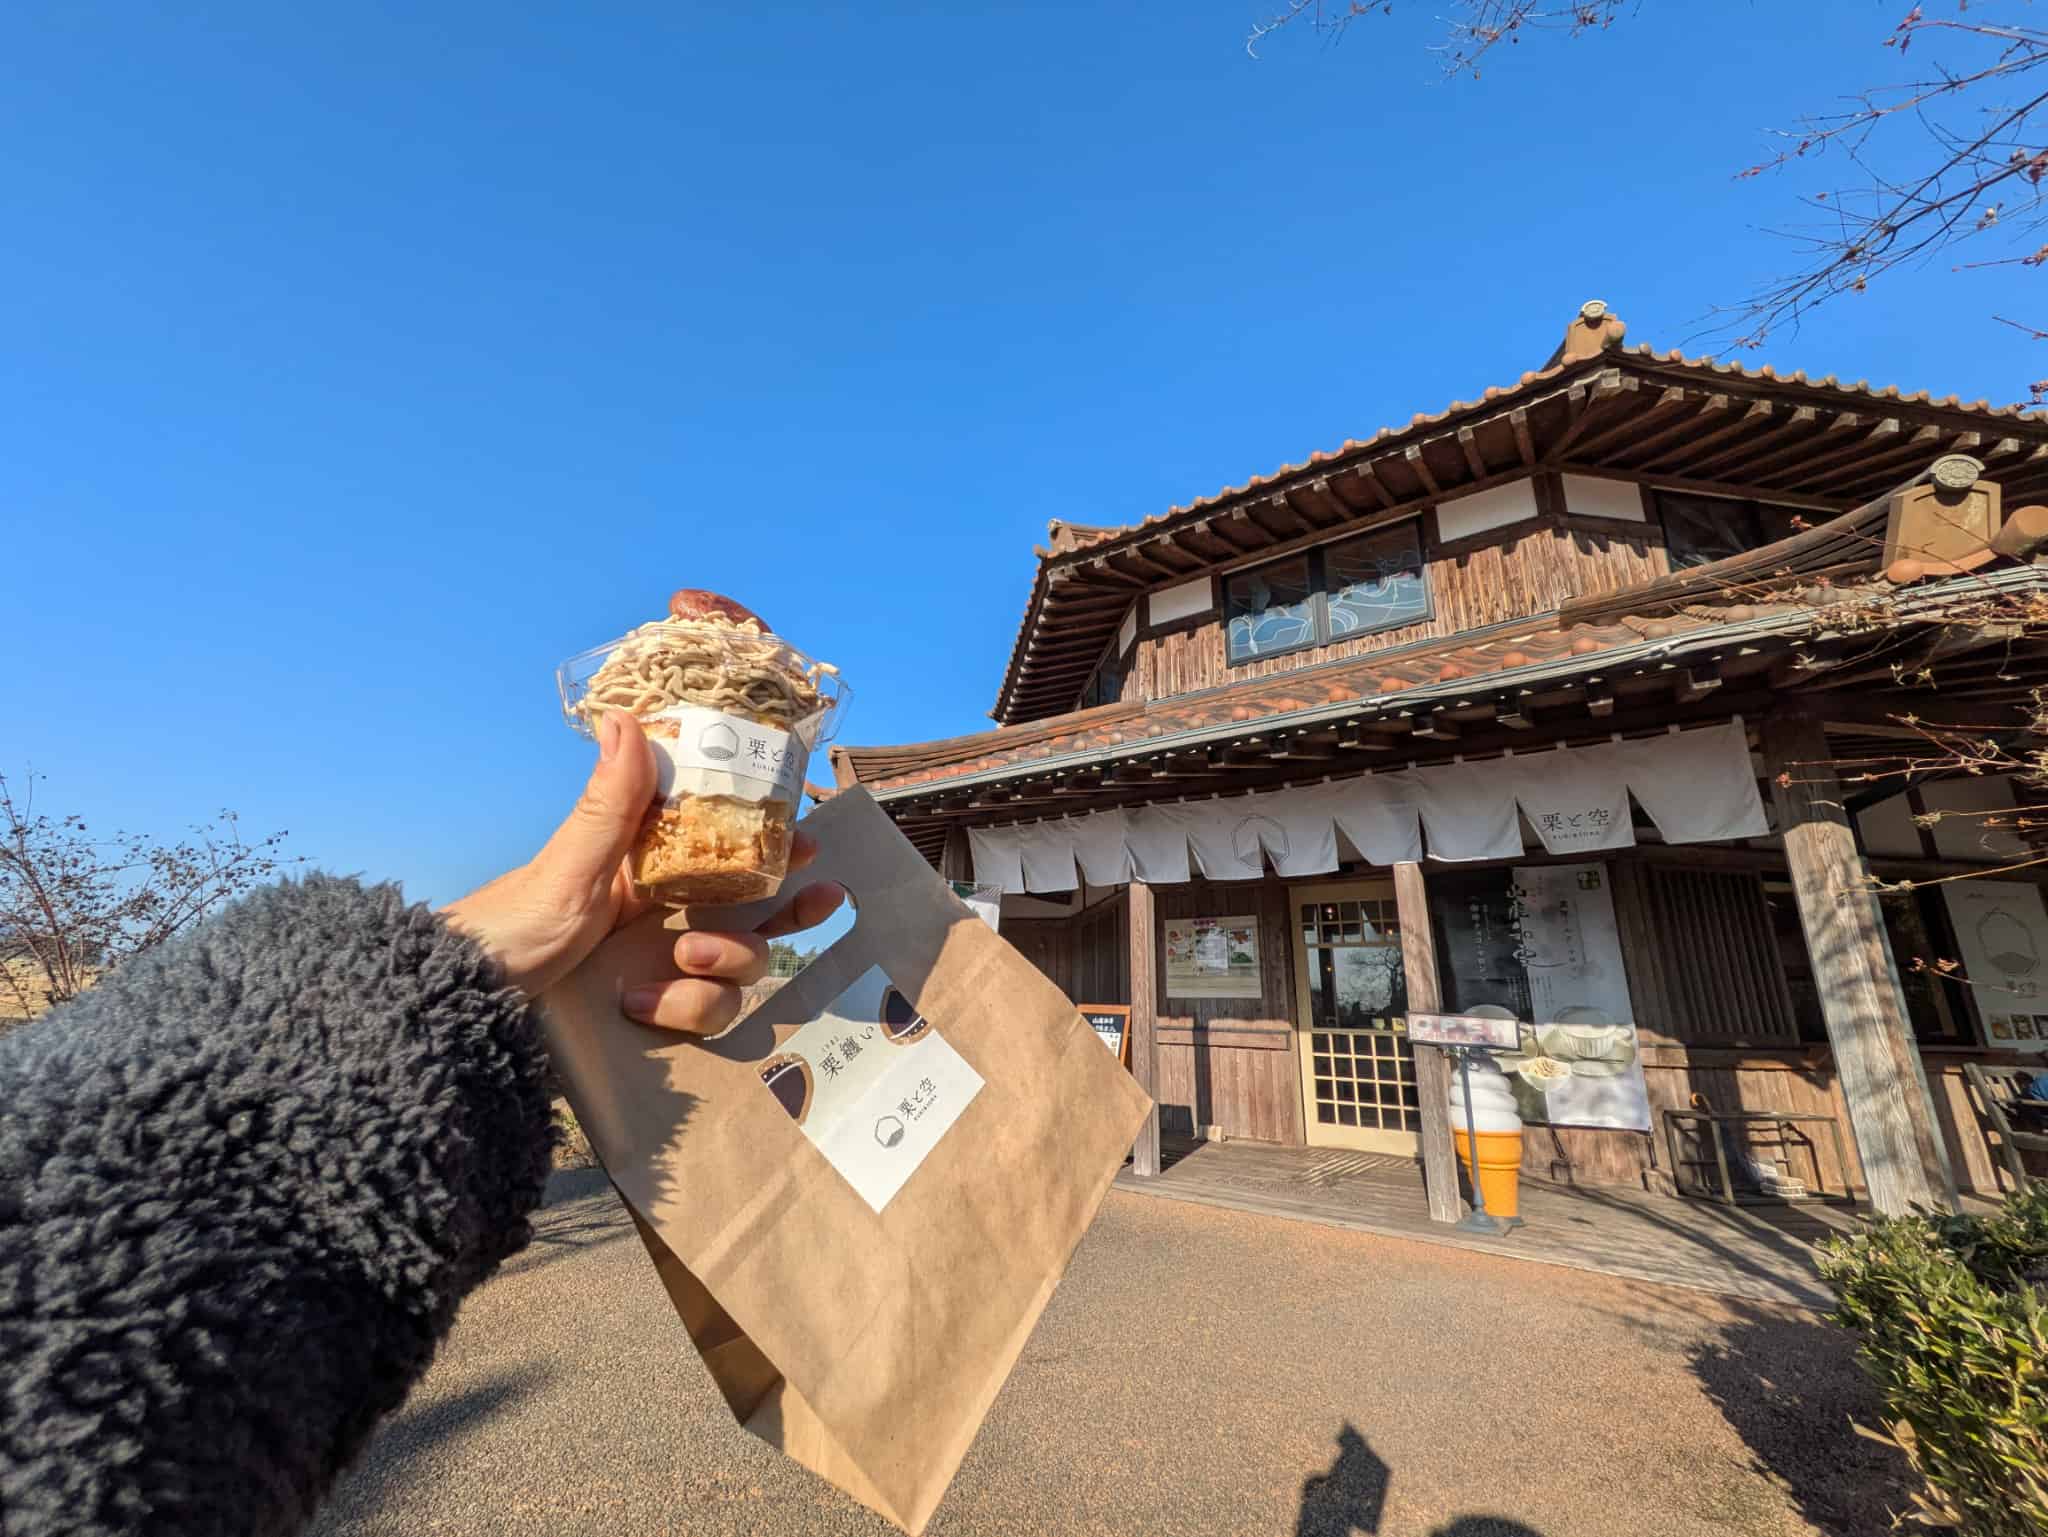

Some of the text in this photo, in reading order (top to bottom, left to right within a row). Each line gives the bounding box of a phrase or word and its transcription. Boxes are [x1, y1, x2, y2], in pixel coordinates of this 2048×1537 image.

[1539, 808, 1609, 832] 栗と空
[896, 1077, 937, 1120] 栗と空
